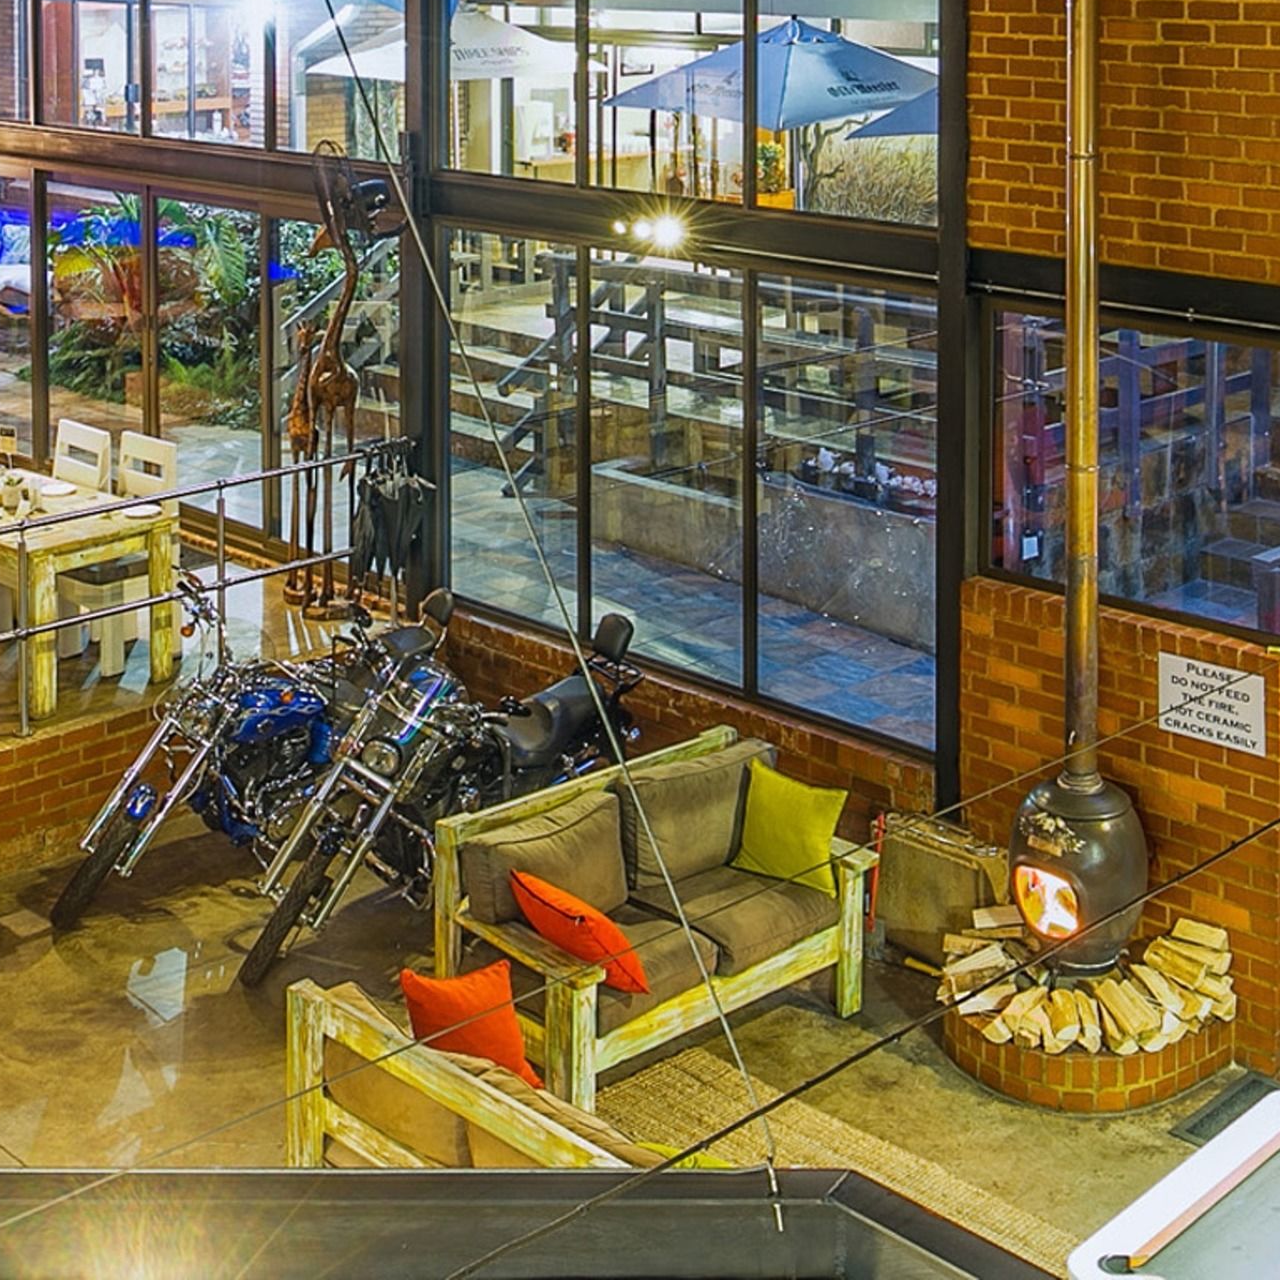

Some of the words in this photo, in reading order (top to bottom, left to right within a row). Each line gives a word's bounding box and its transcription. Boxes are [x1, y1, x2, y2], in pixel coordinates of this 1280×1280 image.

[1186, 663, 1232, 681] PLEASE
[1171, 675, 1188, 687] DO
[1191, 681, 1216, 693] NOT
[1218, 687, 1251, 703] FEED
[1181, 692, 1206, 707] THE
[1196, 711, 1252, 733] CERAMIC
[1164, 717, 1214, 736] CRACKS
[1217, 731, 1258, 750] EASILY
